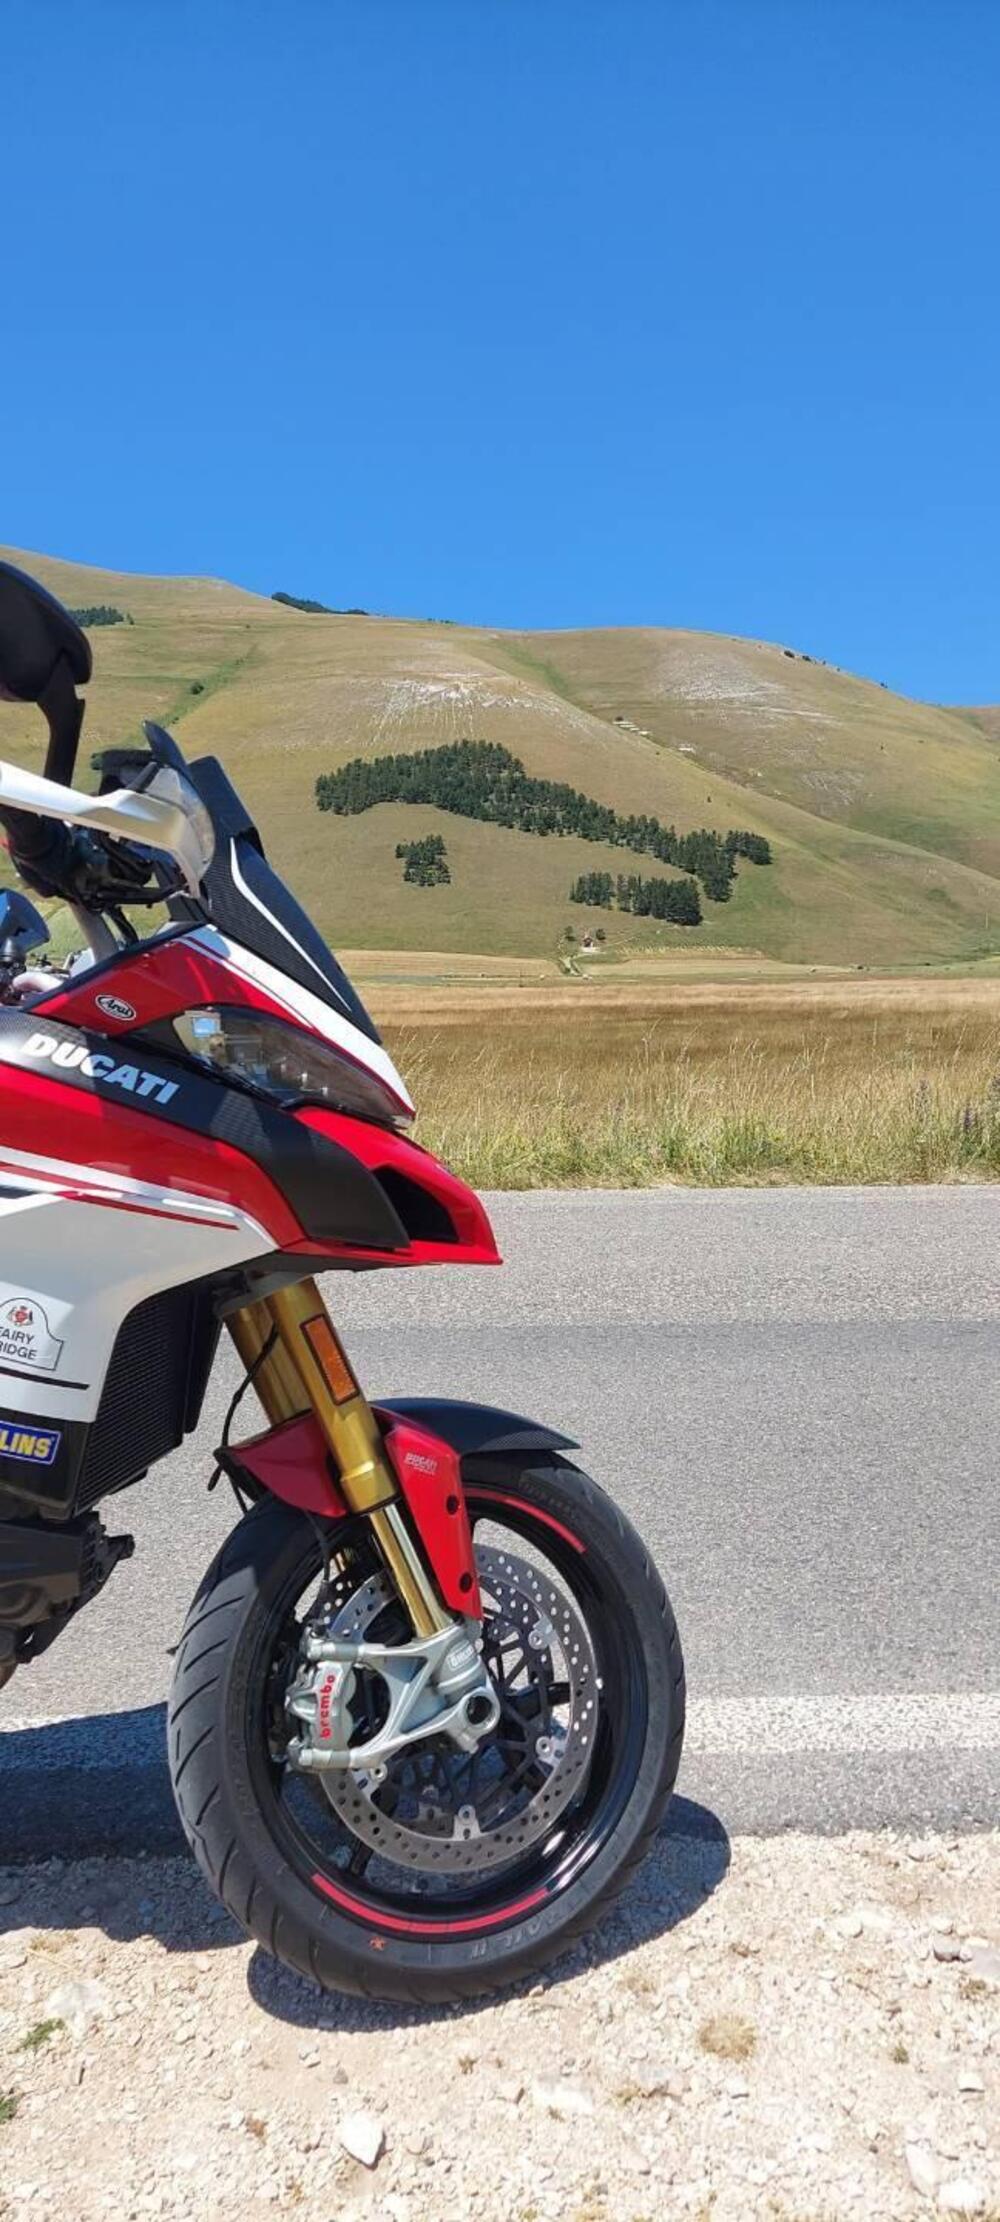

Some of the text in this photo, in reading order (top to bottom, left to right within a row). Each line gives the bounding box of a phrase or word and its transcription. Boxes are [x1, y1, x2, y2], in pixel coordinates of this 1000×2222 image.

[103, 999, 130, 1016] Arai
[21, 1033, 180, 1104] DUCATI
[320, 1674, 336, 1740] brembo
